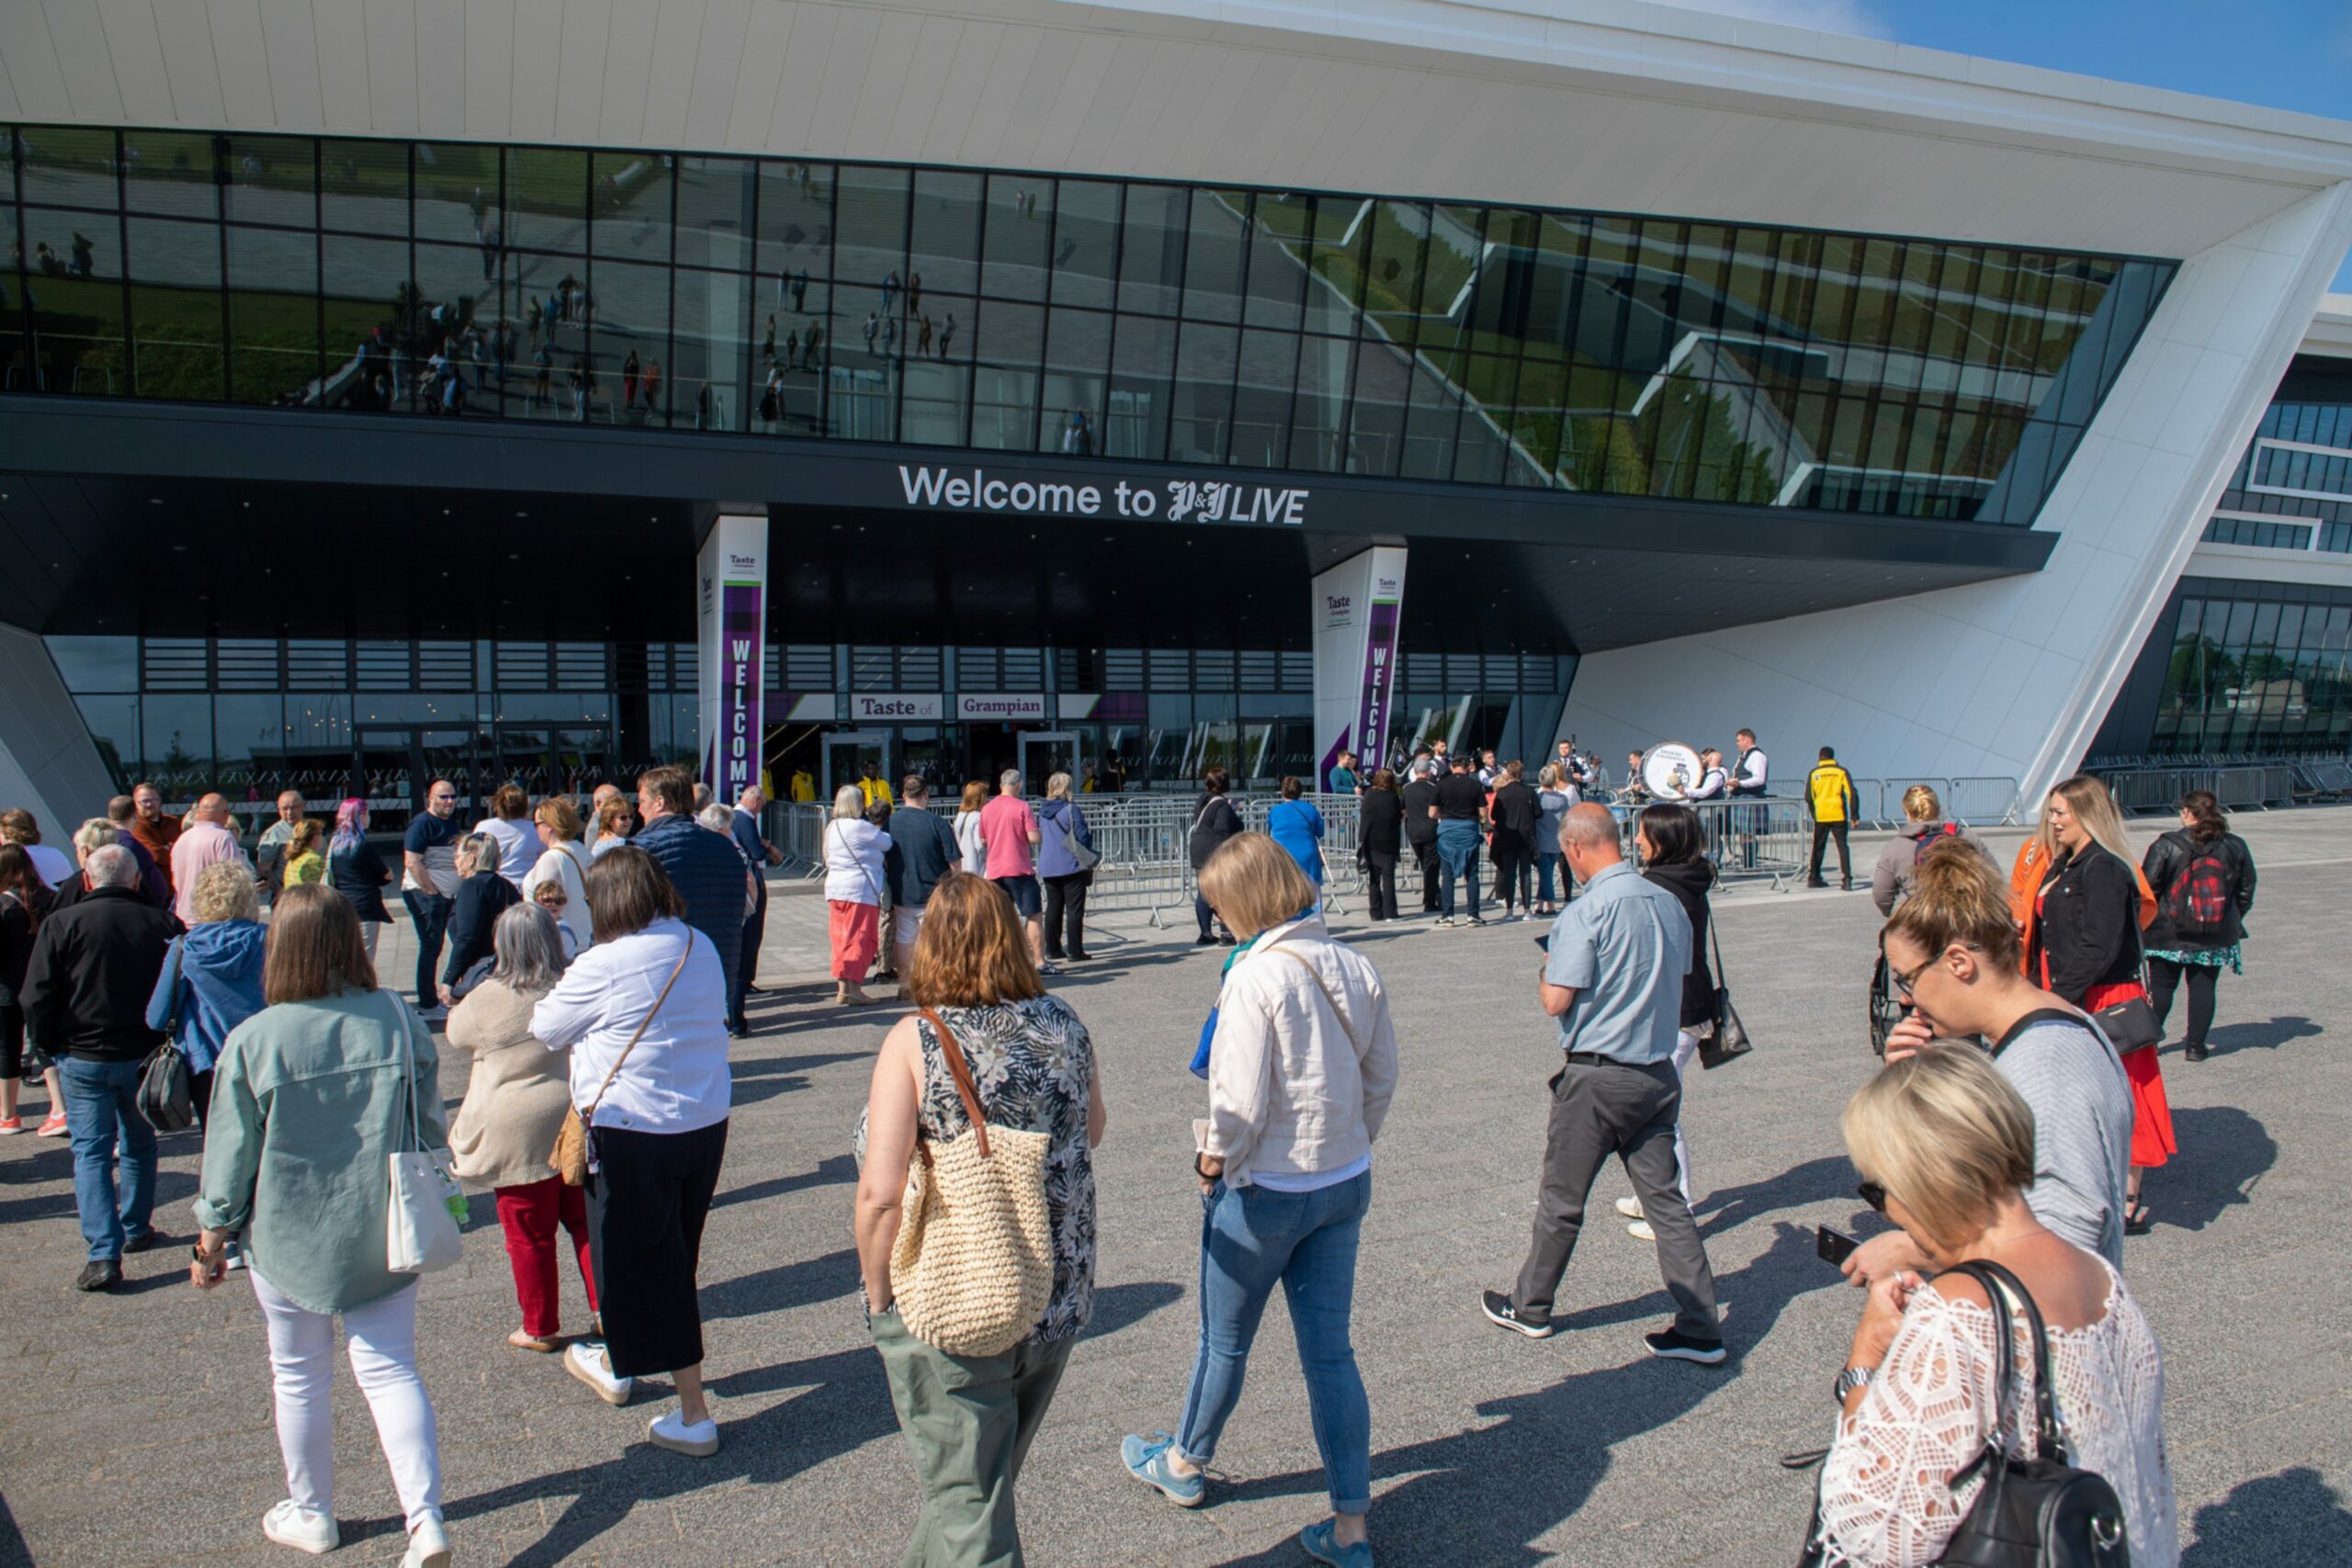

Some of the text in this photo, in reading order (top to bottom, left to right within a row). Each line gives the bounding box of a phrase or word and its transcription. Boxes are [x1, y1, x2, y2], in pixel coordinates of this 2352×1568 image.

[899, 466, 1101, 513] Welcome
[1114, 480, 1157, 517] to
[1229, 487, 1309, 525] LIVE
[729, 554, 755, 564] Taste
[1327, 595, 1351, 610] Taste
[861, 698, 1040, 716] Taste of Grampian
